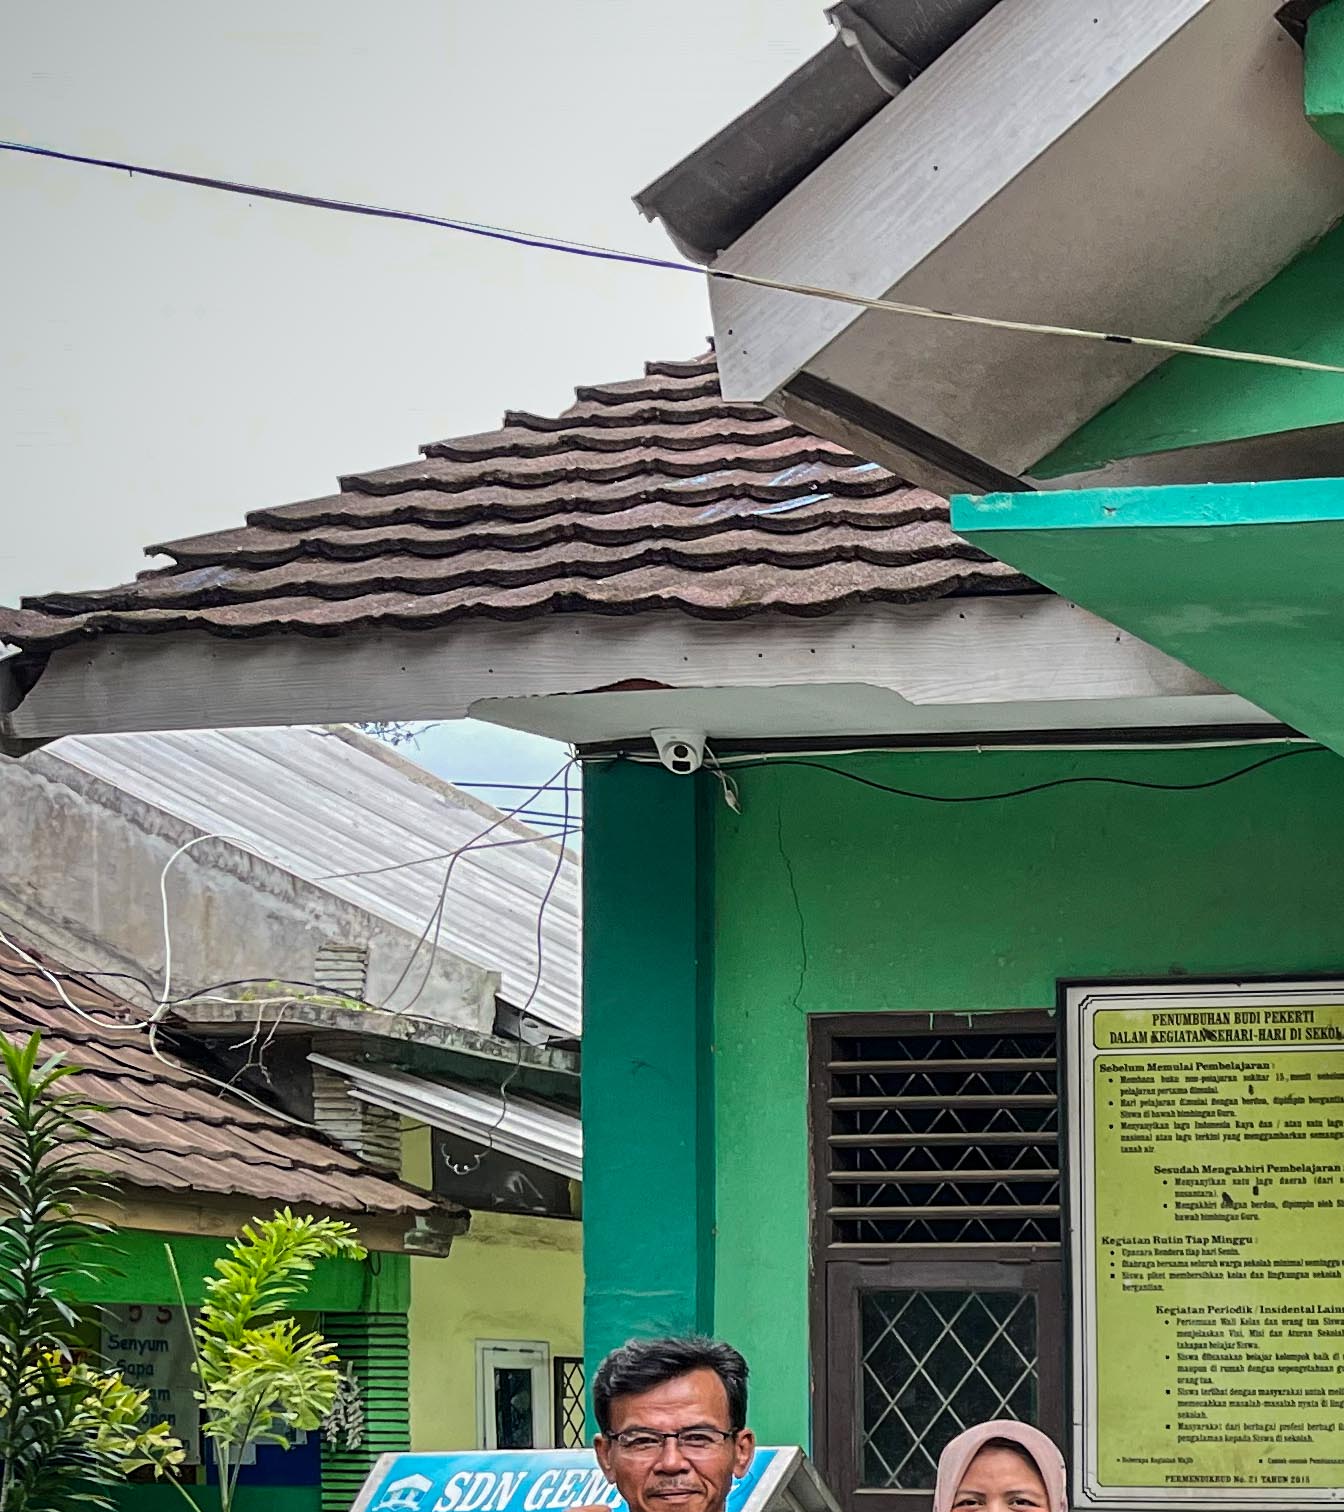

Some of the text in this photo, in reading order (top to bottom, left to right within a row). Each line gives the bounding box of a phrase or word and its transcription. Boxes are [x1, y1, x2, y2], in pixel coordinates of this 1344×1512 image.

[1152, 1009, 1314, 1027] PENUMBUHAN BUDI PEKERTI
[1110, 1030, 1147, 1045] DALAM
[1151, 1028, 1206, 1044] KEGIATAN
[1290, 1027, 1301, 1041] DI
[1147, 1063, 1193, 1071] Memulai
[1195, 1062, 1272, 1071] Pembelajaran
[1154, 1166, 1199, 1174] Sesudah
[1266, 1164, 1341, 1173] Pembelajaran
[1102, 1236, 1252, 1246] Kegiatan Rutin Tiap Minggu
[1156, 1306, 1205, 1316] Kegiatan
[1260, 1305, 1315, 1313] Insidental
[108, 1335, 168, 1355] Senyum
[117, 1359, 154, 1379] Sapa
